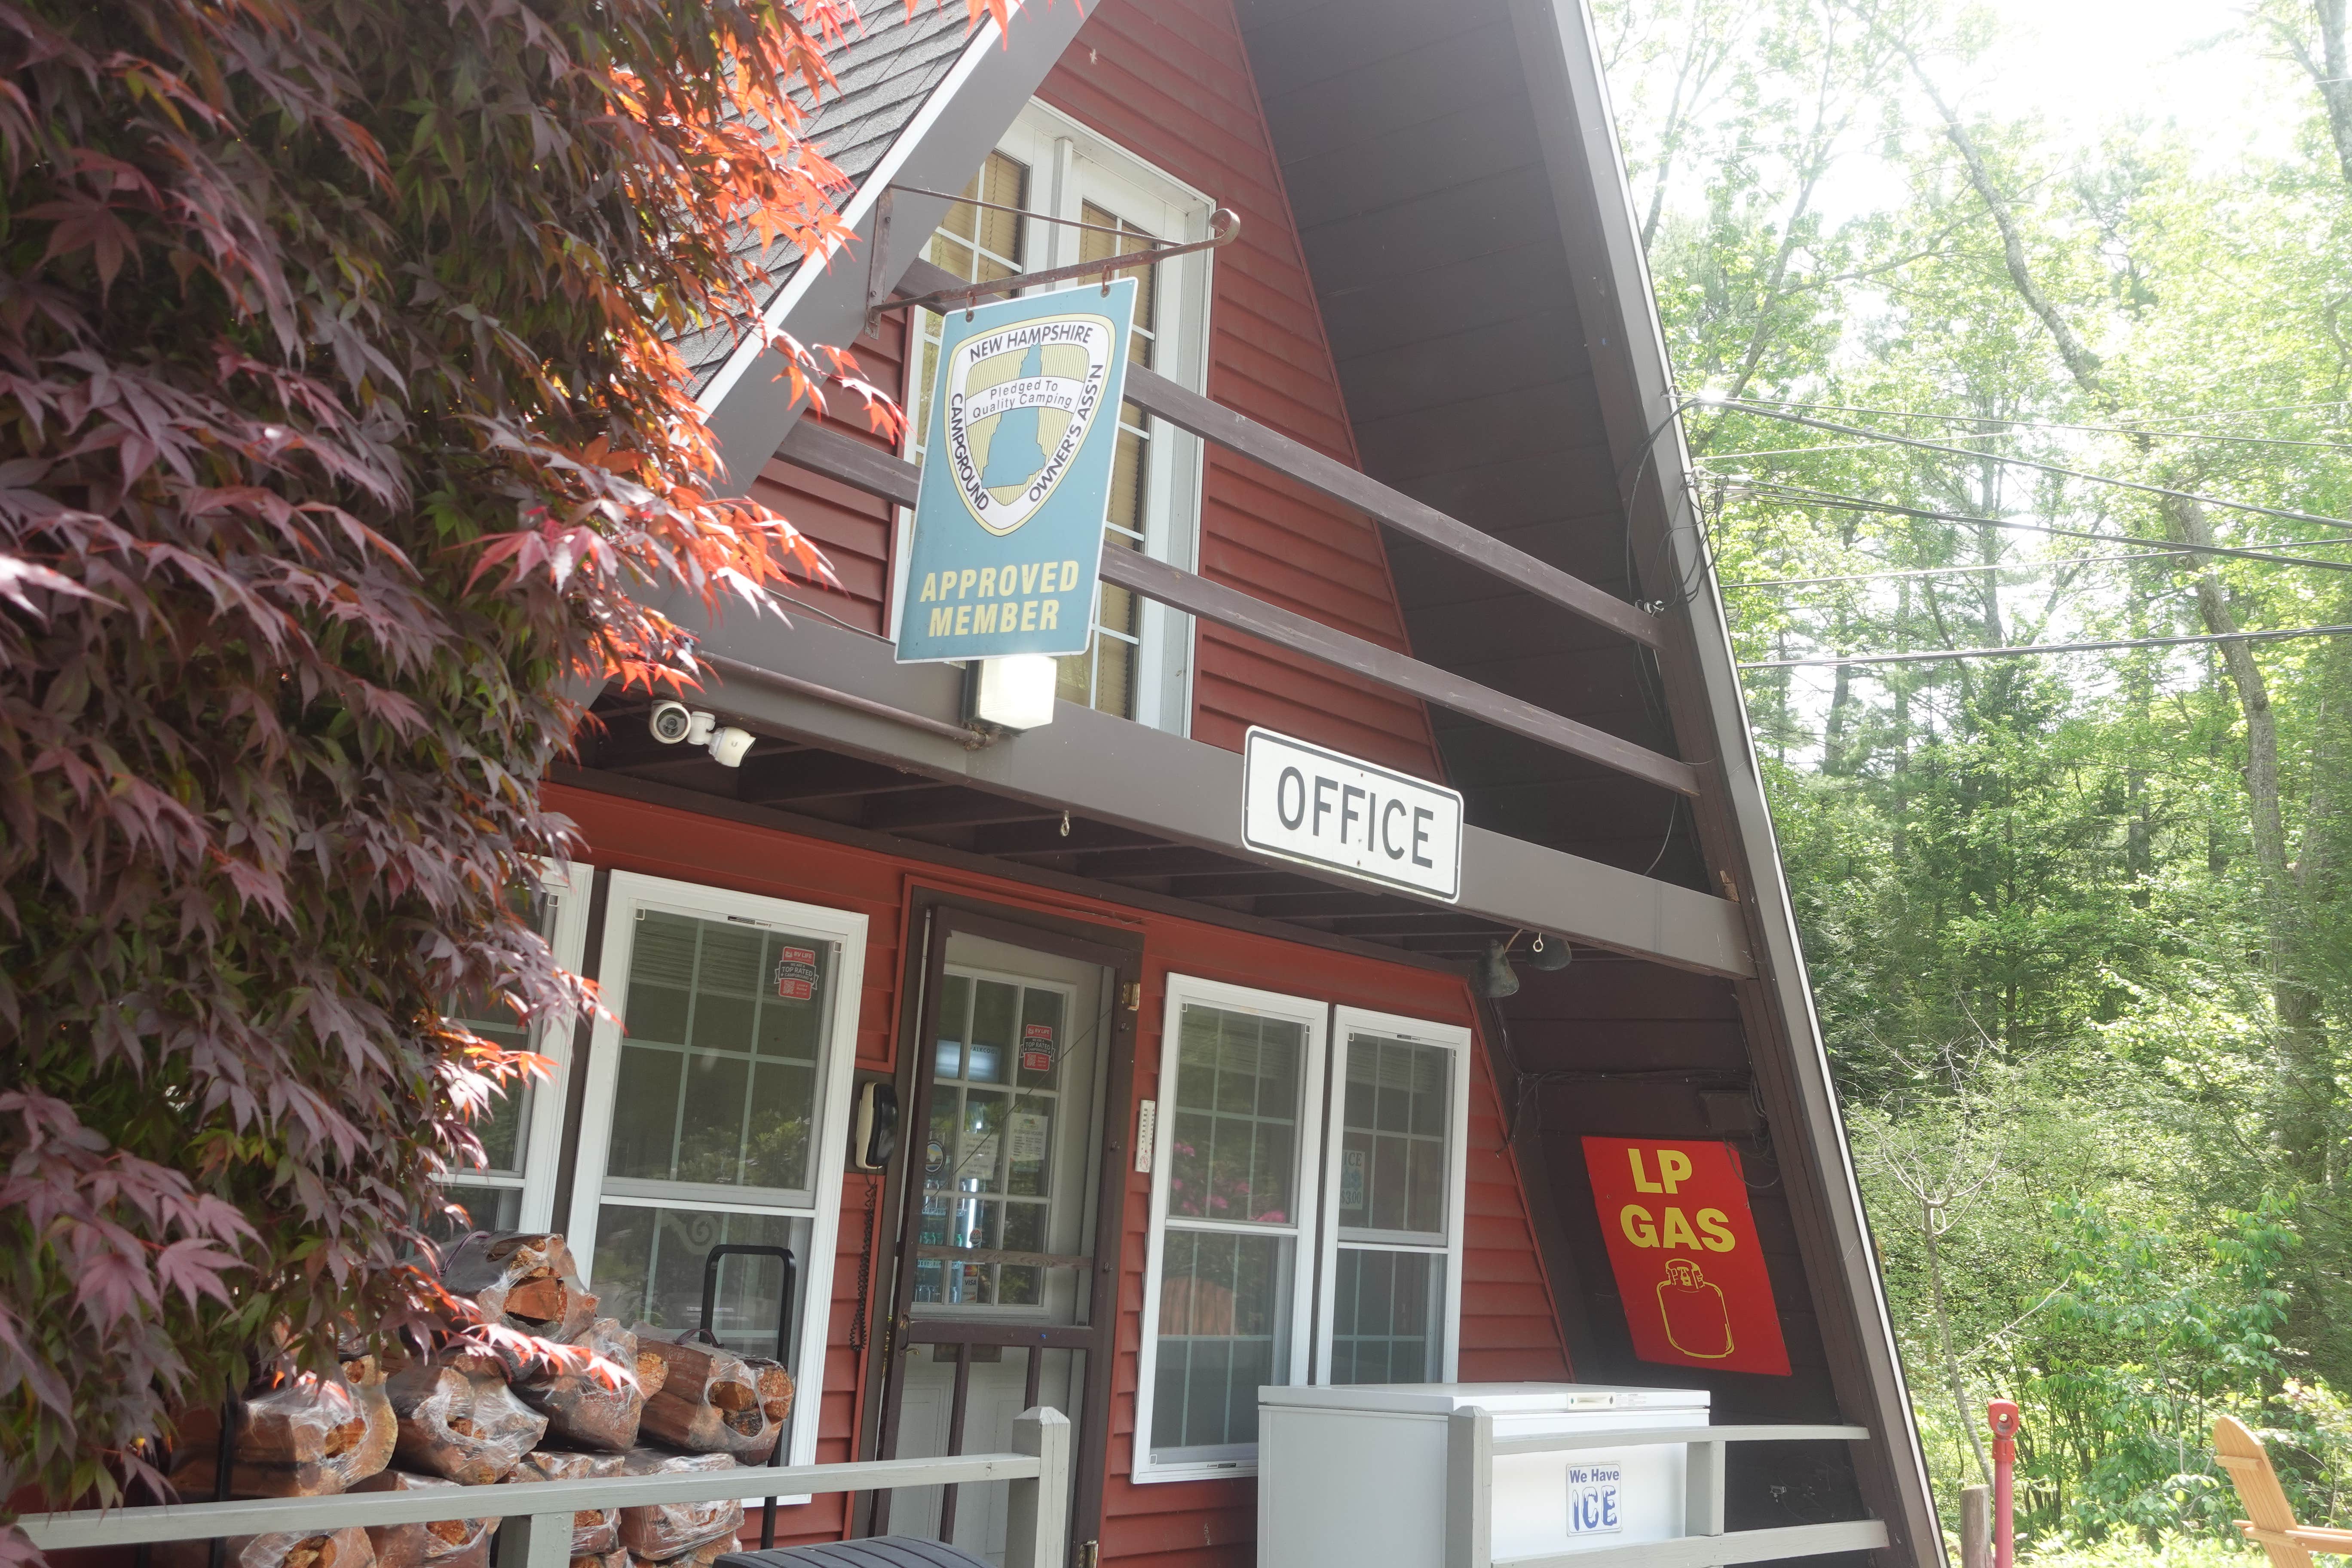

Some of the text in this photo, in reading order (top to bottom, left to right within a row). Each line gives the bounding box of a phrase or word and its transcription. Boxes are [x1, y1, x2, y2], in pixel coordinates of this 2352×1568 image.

[970, 324, 1093, 362] NEW HAMPSHIRE
[973, 393, 1073, 418] Quality Camping
[990, 379, 1058, 400] Pledged To
[951, 393, 989, 511] CAMPGROUND
[1029, 364, 1103, 502] OWNER'S ASS'N
[919, 560, 1079, 603] APPROVED
[928, 599, 1060, 637] MEMBER
[1277, 766, 1434, 869] OFFICE
[794, 968, 813, 977] RATED
[1343, 1152, 1362, 1167] ICE
[1627, 1148, 1693, 1194] LP
[1620, 1204, 1736, 1253] GAS
[1570, 1468, 1620, 1483] We Have
[1572, 1485, 1617, 1531] ICE
